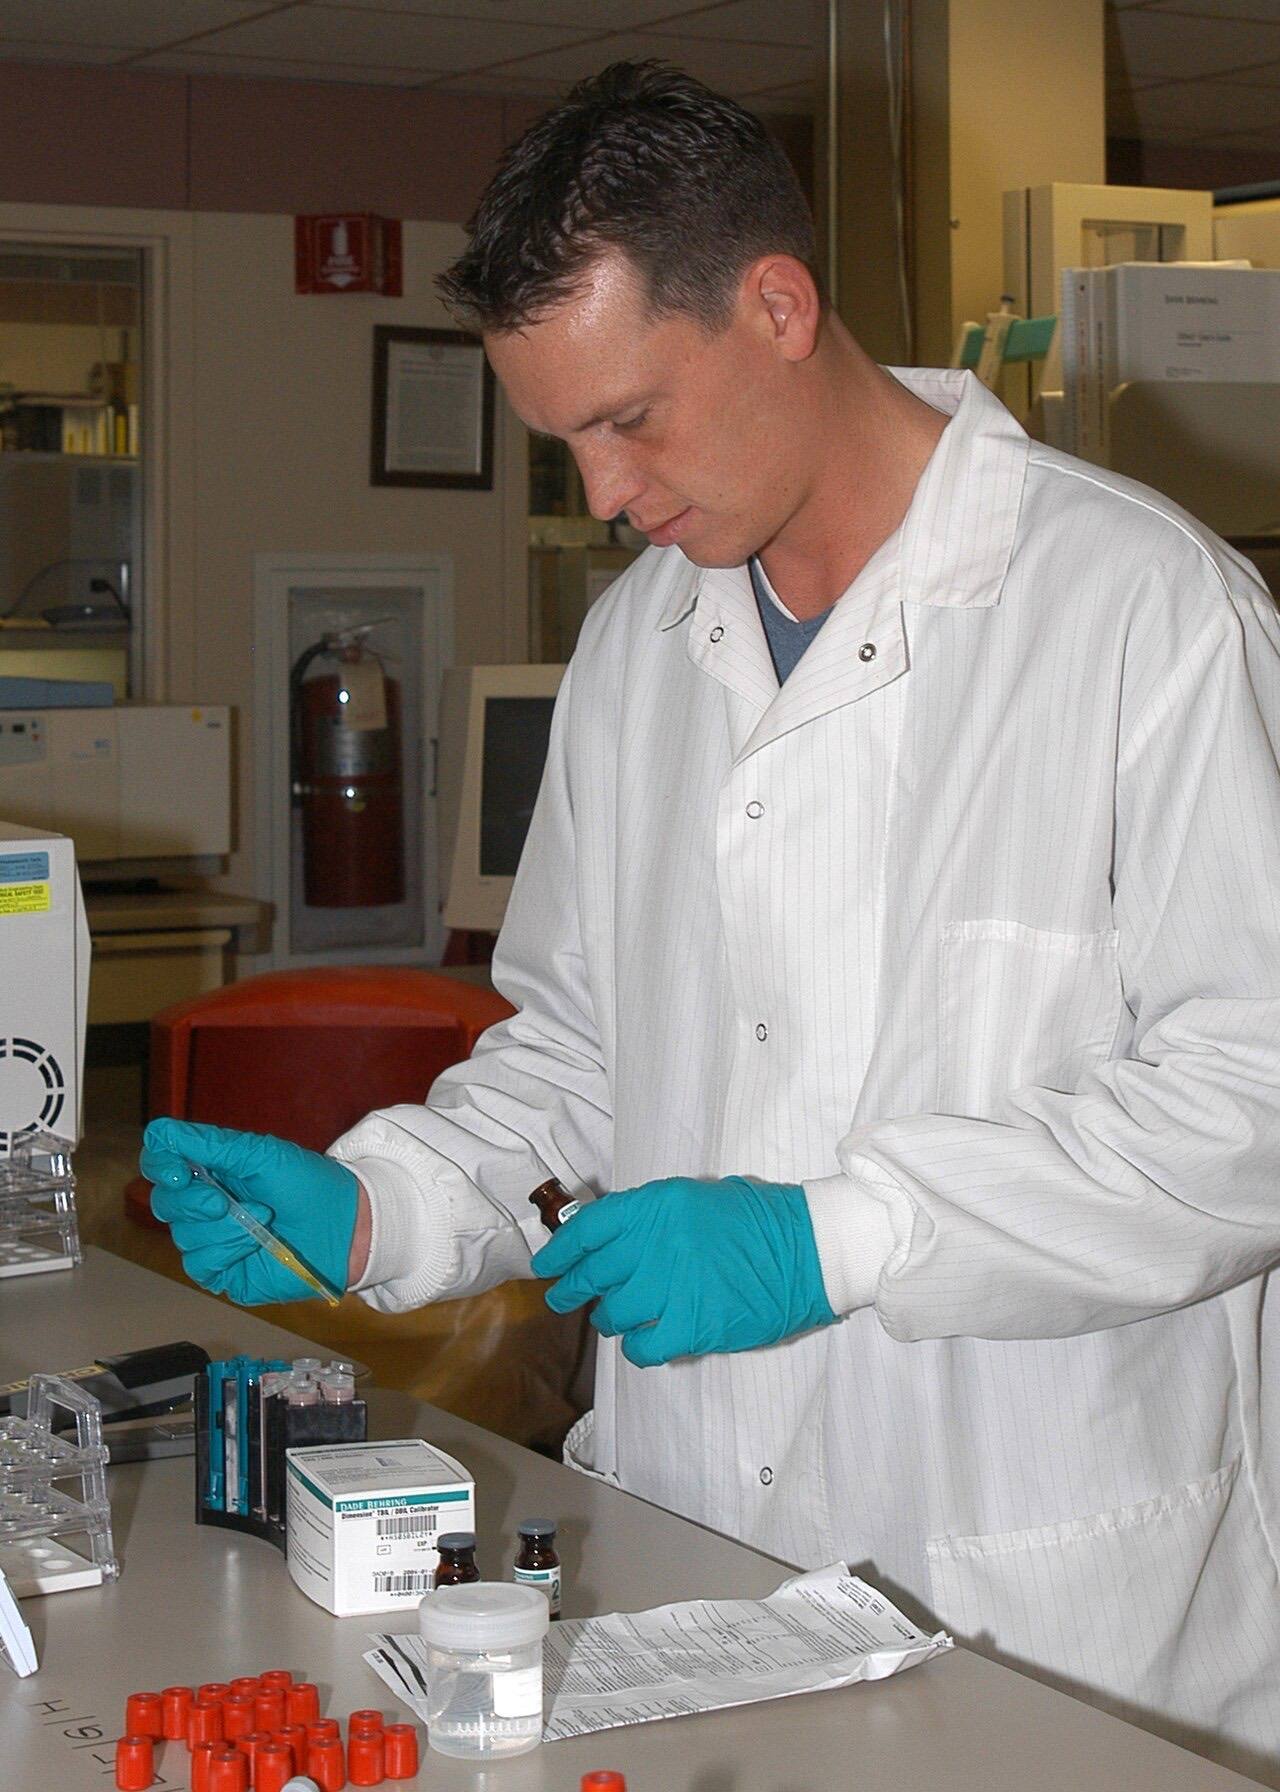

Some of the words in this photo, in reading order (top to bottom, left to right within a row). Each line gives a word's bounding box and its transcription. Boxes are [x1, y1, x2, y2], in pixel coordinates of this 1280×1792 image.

[340, 1501, 365, 1512] DADE
[367, 1497, 407, 1509] BEHRING
[551, 1579, 560, 1600] 2
